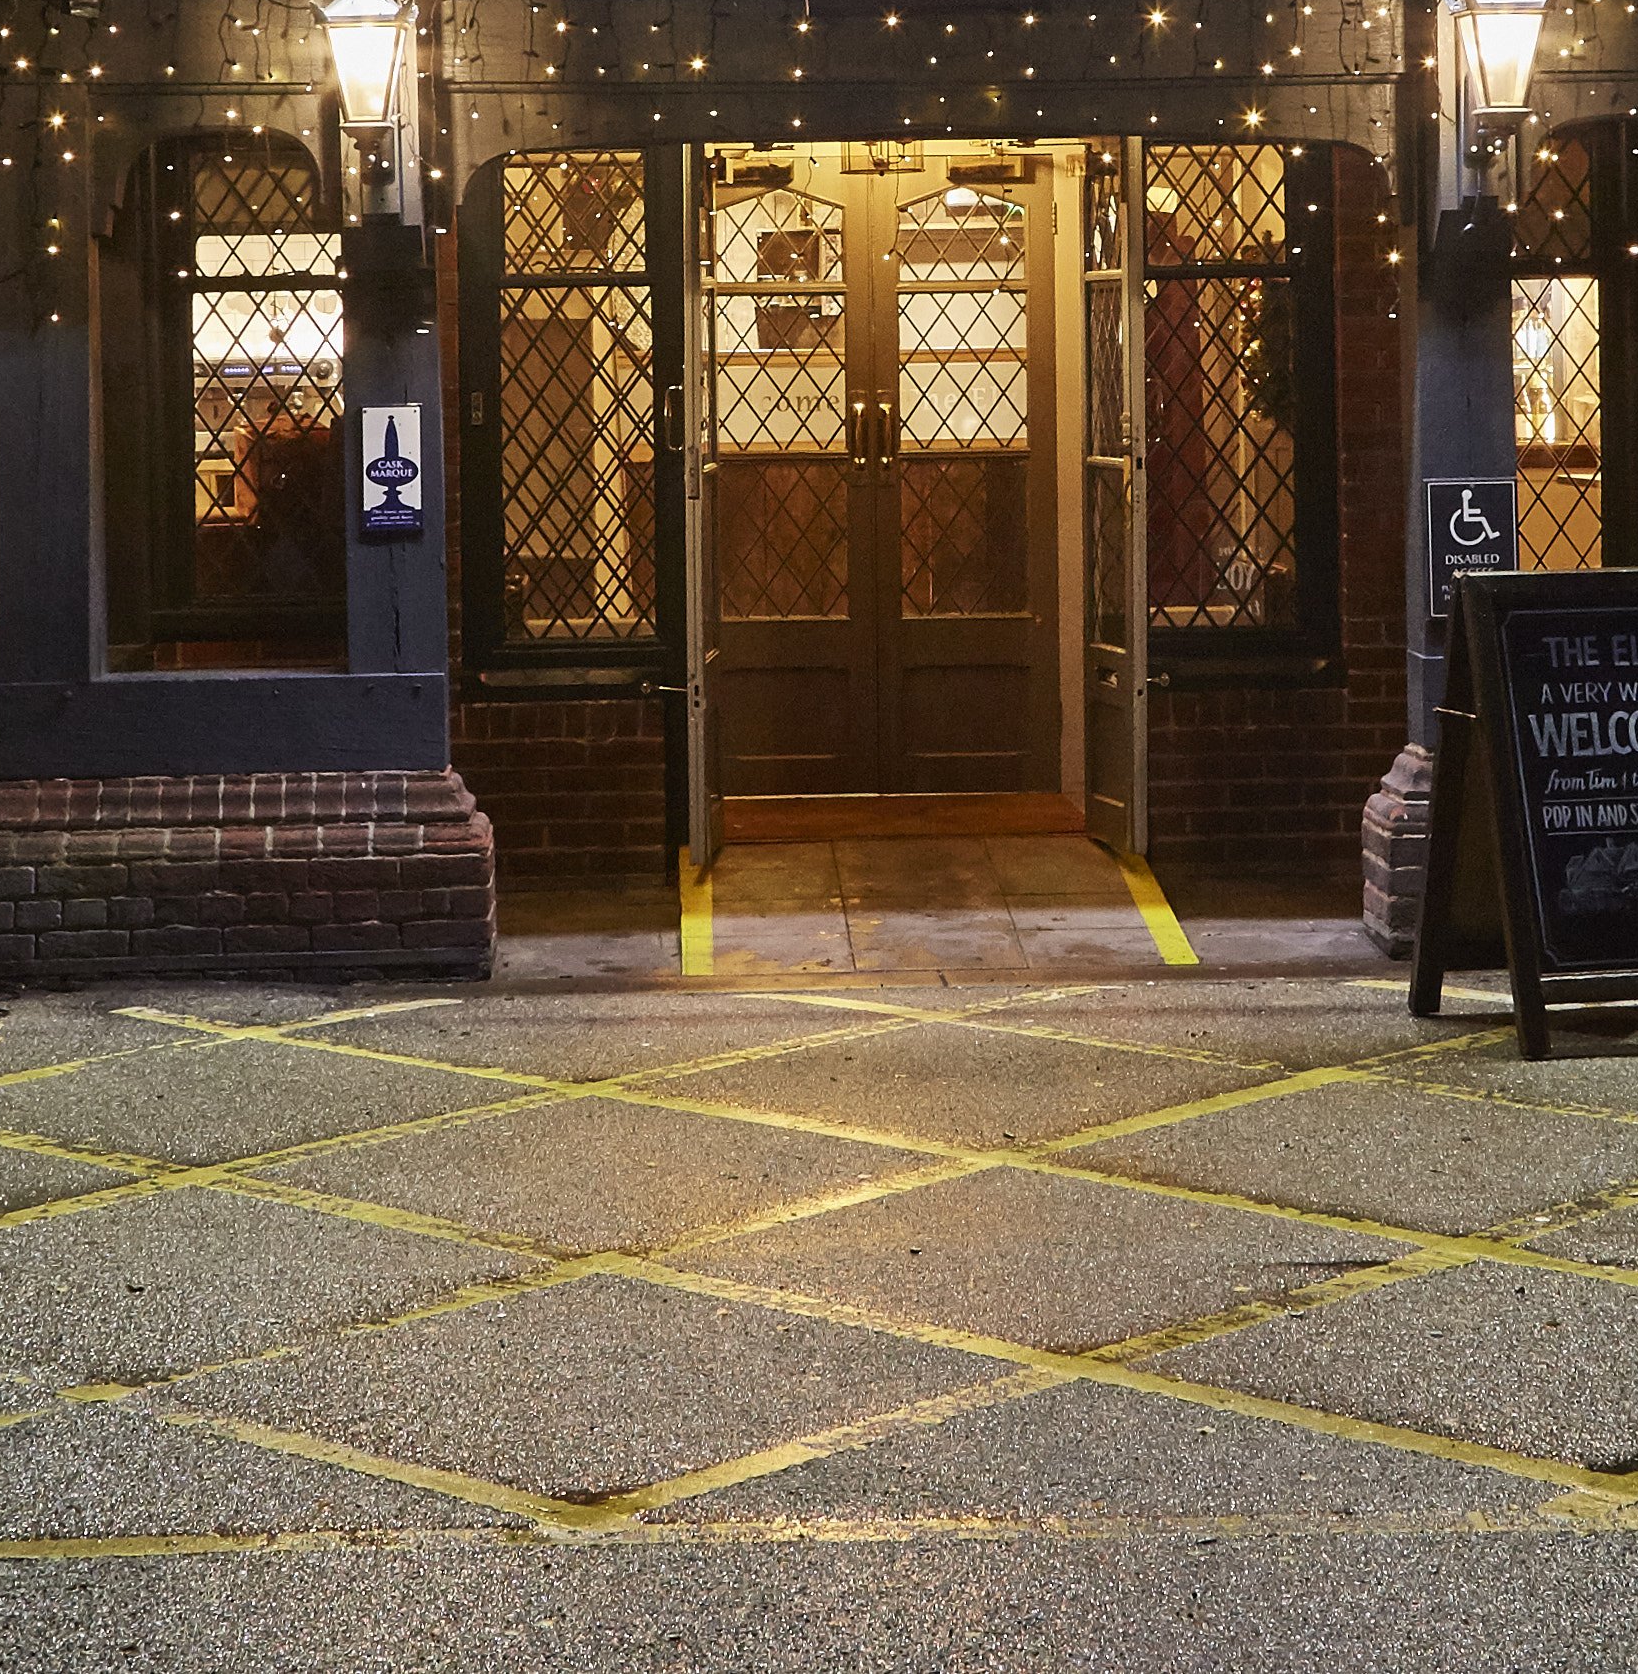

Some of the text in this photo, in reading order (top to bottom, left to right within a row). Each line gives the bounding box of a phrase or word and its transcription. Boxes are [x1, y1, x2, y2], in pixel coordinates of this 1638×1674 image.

[370, 468, 413, 478] MARQUE
[377, 460, 404, 469] CASK
[1445, 553, 1500, 565] DISABLED
[1542, 635, 1601, 668] THE
[1541, 682, 1554, 705] A
[1560, 681, 1612, 704] VERY
[1545, 768, 1586, 794] from
[1586, 768, 1617, 790] Tim
[1543, 804, 1572, 829] POP
[1575, 804, 1593, 828] IN
[1597, 803, 1627, 828] AND
